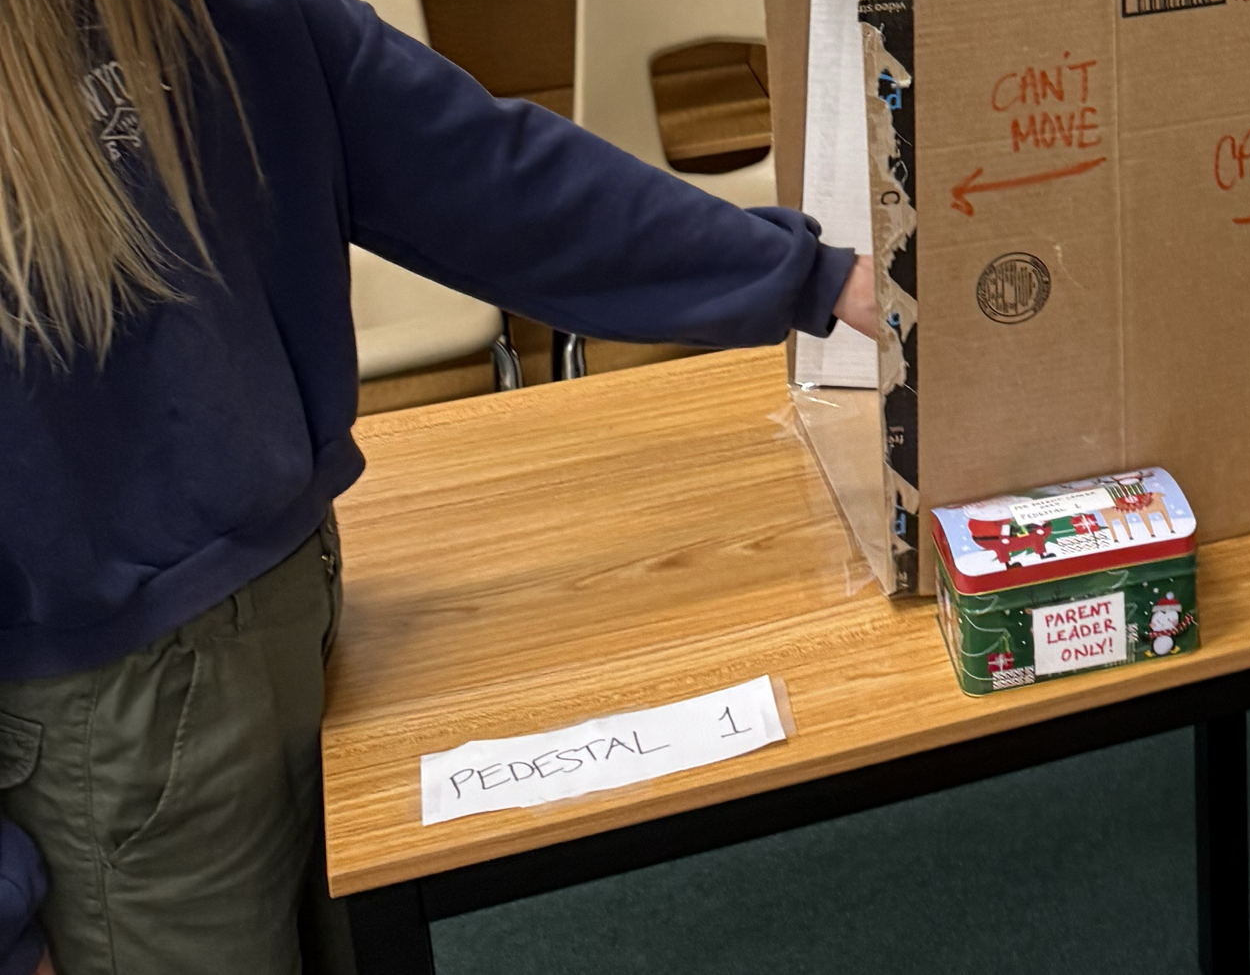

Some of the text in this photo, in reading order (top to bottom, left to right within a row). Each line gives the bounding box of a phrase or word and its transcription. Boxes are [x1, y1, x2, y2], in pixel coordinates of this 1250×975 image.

[991, 50, 1097, 112] CAN'T
[1010, 106, 1102, 153] MOVE
[1044, 600, 1112, 628] PARENT
[1046, 618, 1117, 645] LEADER
[1060, 636, 1114, 663] ONLY!
[449, 707, 752, 799] PEDESTAL 1
